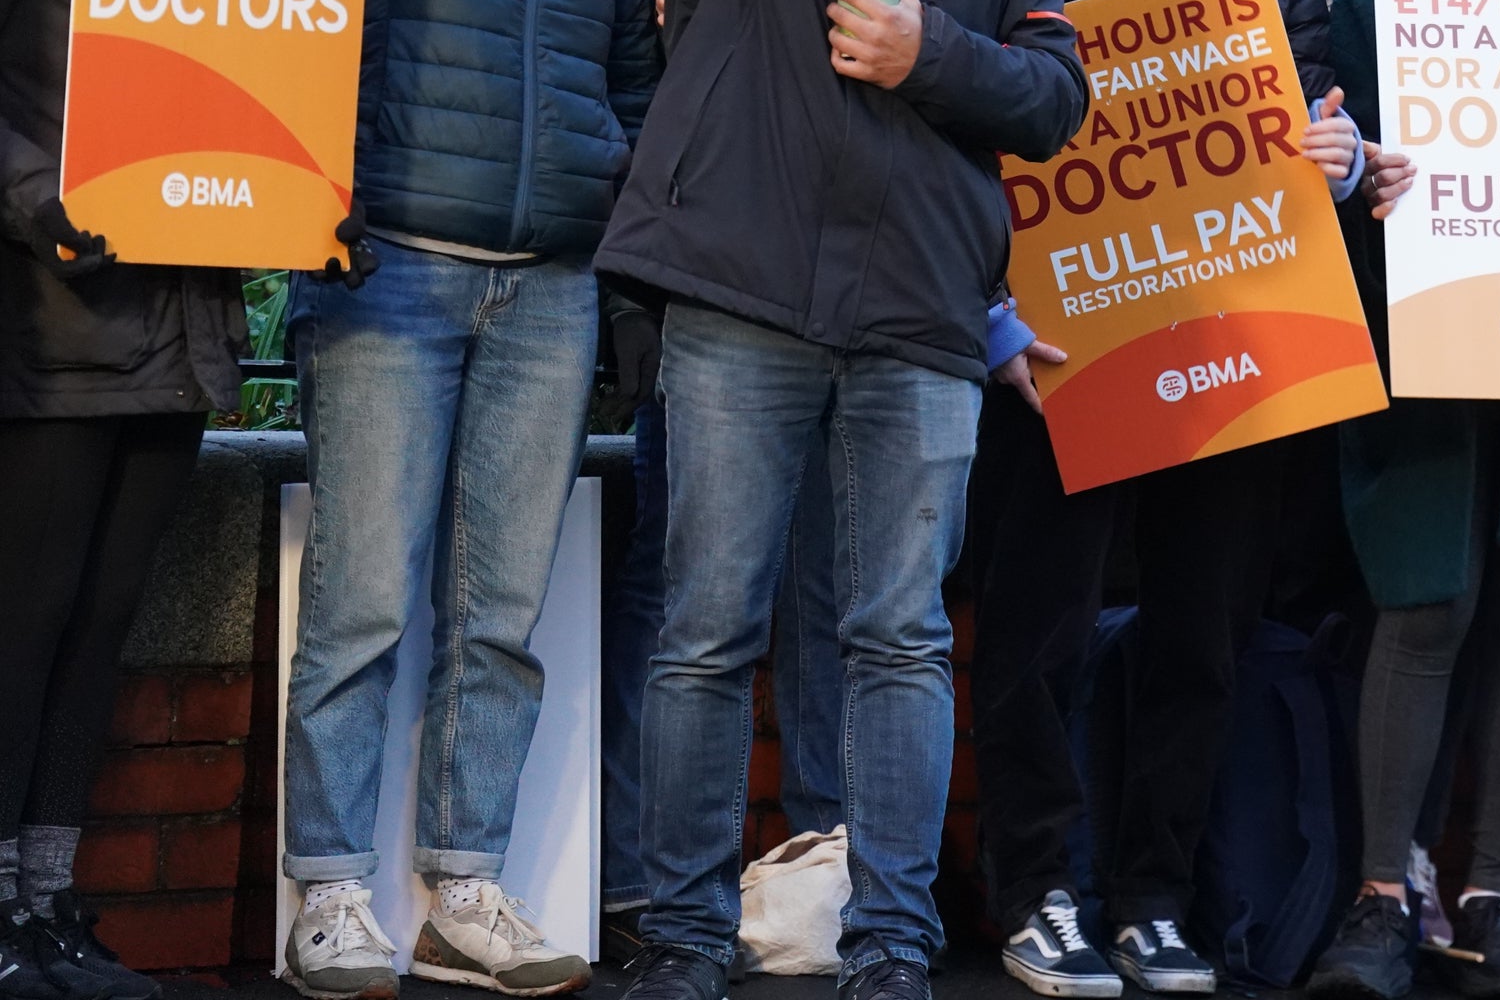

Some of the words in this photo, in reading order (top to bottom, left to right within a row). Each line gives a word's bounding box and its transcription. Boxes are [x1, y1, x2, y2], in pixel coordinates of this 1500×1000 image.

[1078, 0, 1206, 65] HOUR
[1091, 56, 1167, 100] FAIR
[1173, 27, 1273, 76] WAGE
[1395, 23, 1464, 49] NOT
[1474, 25, 1497, 49] A
[1091, 109, 1121, 146] A
[1130, 64, 1284, 141] JUNIOR
[1397, 56, 1481, 89] FOR
[192, 175, 253, 208] BMA
[1003, 107, 1300, 233] DOCTOR
[1049, 223, 1188, 292] FULL
[1195, 190, 1287, 254] PAY
[1062, 253, 1235, 317] RESTORATION
[1241, 236, 1298, 266] NOW
[1190, 352, 1261, 393] BMA
